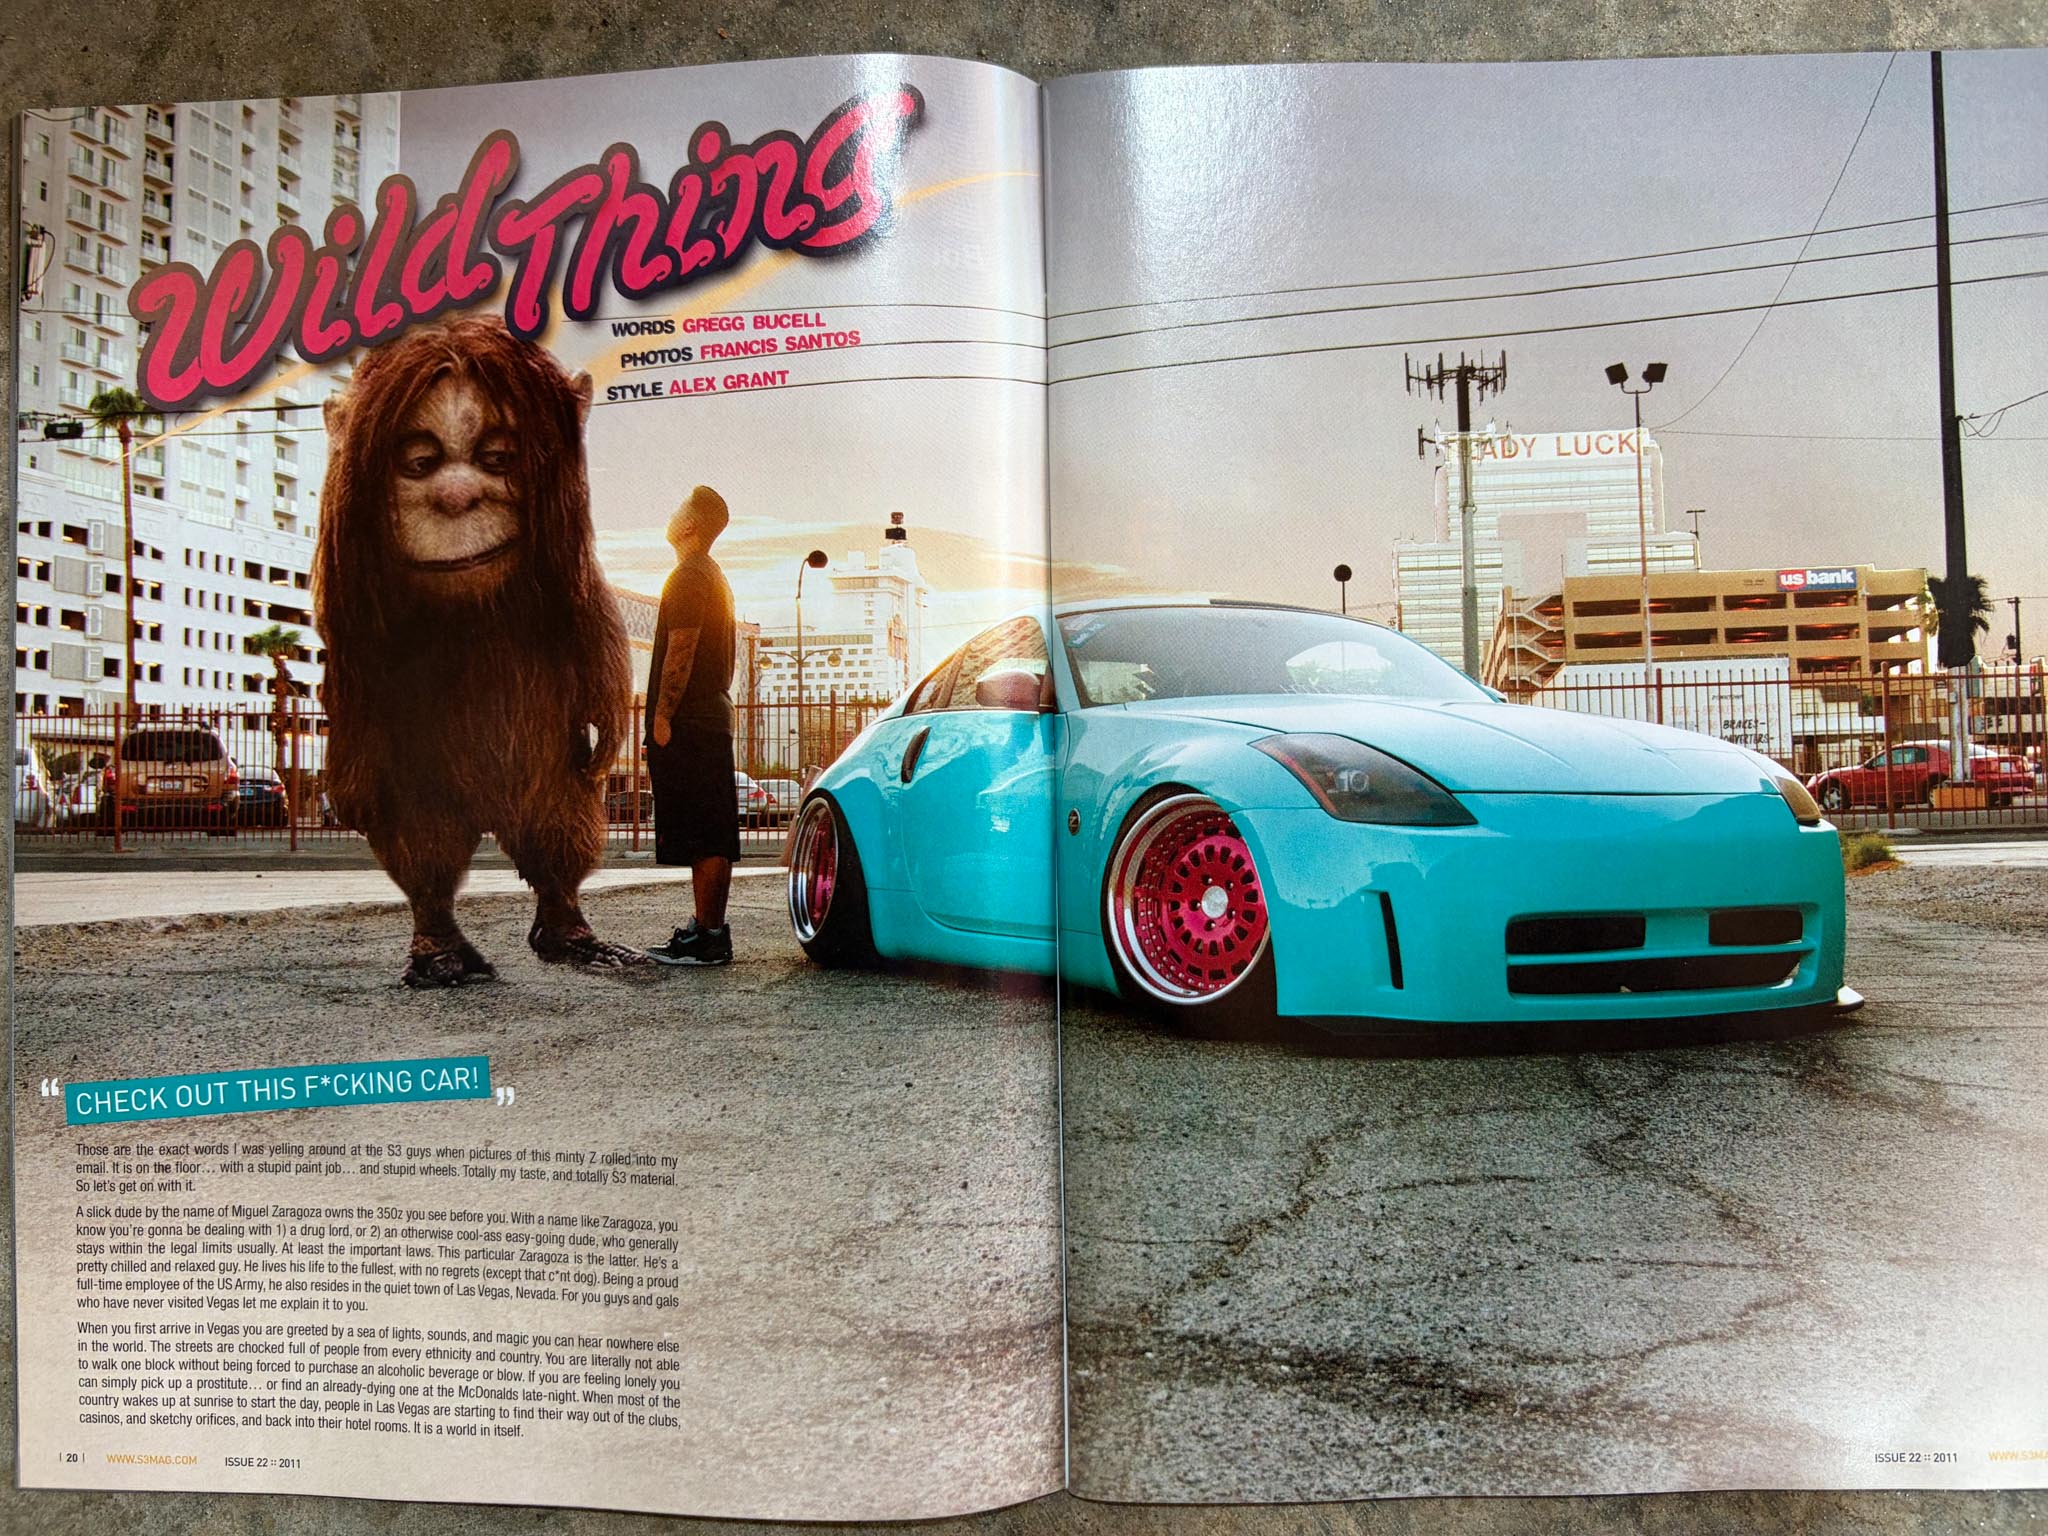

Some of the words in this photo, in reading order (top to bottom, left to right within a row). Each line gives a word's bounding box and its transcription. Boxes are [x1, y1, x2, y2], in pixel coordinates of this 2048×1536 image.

[127, 129, 502, 412] Wild
[488, 83, 925, 341] Thing
[612, 320, 675, 337] WORDS
[683, 316, 744, 333] GREGG
[753, 312, 826, 331] BUCELL
[621, 347, 693, 368] PHOTOS
[700, 338, 778, 360] FRANCIS
[785, 331, 861, 352] SANTOS
[607, 382, 663, 401] STYLE
[669, 376, 716, 395] ALEX
[723, 370, 789, 390] GRANT
[1467, 437, 1537, 461] ADY
[1556, 432, 1636, 457] LUCK
[76, 1087, 168, 1115] CHECK
[176, 1082, 229, 1107] OUT
[237, 1077, 296, 1103] THIS
[420, 1066, 479, 1092] CAR!
[76, 1178, 90, 1192] So
[118, 1178, 137, 1195] get
[139, 1181, 154, 1191] on
[156, 1178, 182, 1191] with
[184, 1178, 196, 1191] it.
[76, 1204, 84, 1217] A
[86, 1204, 112, 1217] slick
[114, 1204, 142, 1217] dude
[144, 1204, 159, 1221] by
[161, 1204, 180, 1217] the
[182, 1207, 214, 1217] name
[217, 1204, 228, 1217] of
[231, 1204, 269, 1221] Miguel
[271, 1204, 322, 1221] Zaragoza
[324, 1207, 354, 1218] owns
[356, 1205, 374, 1219] the
[376, 1205, 403, 1219] 350z
[405, 1209, 425, 1223] you
[427, 1210, 447, 1221] see
[449, 1208, 484, 1222] before
[486, 1212, 508, 1227] you.
[510, 1210, 535, 1224] With
[537, 1214, 544, 1225] a
[546, 1215, 578, 1227] name
[580, 1214, 600, 1228] like
[602, 1215, 656, 1234] Zaragoza,
[658, 1220, 678, 1235] you
[76, 1294, 100, 1307] who
[102, 1294, 130, 1308] have
[132, 1297, 164, 1308] never
[167, 1295, 204, 1308] visited
[206, 1295, 240, 1312] Vegas
[242, 1296, 256, 1309] let
[259, 1299, 277, 1309] me
[280, 1296, 319, 1313] explain
[322, 1296, 330, 1309] it
[332, 1297, 343, 1310] to
[345, 1299, 369, 1313] you.
[78, 1320, 108, 1333] When
[110, 1323, 131, 1337] you
[134, 1321, 156, 1334] first
[158, 1321, 191, 1334] arrive
[194, 1321, 204, 1334] in
[206, 1321, 240, 1338] Vegas
[242, 1325, 262, 1338] you
[265, 1325, 284, 1335] are
[286, 1322, 328, 1340] greeted
[330, 1323, 344, 1340] by
[346, 1326, 354, 1337] a
[356, 1327, 376, 1338] sea
[378, 1325, 389, 1338] of
[392, 1325, 424, 1343] lights,
[426, 1326, 470, 1343] sounds,
[472, 1328, 493, 1343] and
[495, 1330, 529, 1348] magic
[532, 1334, 551, 1349] you
[554, 1335, 574, 1347] can
[577, 1334, 603, 1348] hear
[606, 1335, 654, 1351] nowhere
[656, 1338, 679, 1352] else
[78, 1357, 89, 1369] to
[91, 1356, 118, 1369] walk
[120, 1359, 141, 1370] one
[144, 1357, 175, 1370] block
[178, 1357, 220, 1371] without
[222, 1358, 253, 1375] being
[256, 1358, 291, 1372] forced
[294, 1360, 305, 1372] to
[308, 1359, 358, 1378] purchase
[360, 1364, 374, 1375] an
[377, 1362, 425, 1377] alcoholic
[428, 1364, 479, 1383] beverage
[482, 1369, 494, 1380] or
[496, 1367, 525, 1382] blow.
[527, 1369, 535, 1382] If
[538, 1372, 559, 1387] you
[562, 1373, 580, 1384] are
[583, 1371, 621, 1389] feeling
[624, 1373, 657, 1391] lonely
[659, 1378, 680, 1392] you
[78, 1377, 98, 1387] can
[100, 1374, 137, 1391] simply
[140, 1375, 164, 1392] pick
[167, 1378, 182, 1392] up
[185, 1378, 193, 1389] a
[265, 1380, 278, 1390] or
[280, 1377, 302, 1391] find
[304, 1380, 319, 1391] an
[322, 1378, 396, 1398] already-dying
[398, 1384, 419, 1395] one
[422, 1383, 434, 1396] at
[436, 1383, 454, 1397] the
[458, 1384, 518, 1400] McDonalds
[521, 1387, 579, 1406] late-night.
[582, 1390, 614, 1405] When
[616, 1392, 645, 1406] most
[648, 1393, 659, 1407] of
[662, 1394, 680, 1408] the
[79, 1410, 123, 1426] casinos,
[125, 1411, 146, 1424] and
[149, 1411, 192, 1428] sketchy
[195, 1412, 238, 1427] orifices,
[241, 1412, 262, 1426] and
[264, 1413, 292, 1426] back
[294, 1413, 315, 1428] into
[317, 1415, 342, 1429] their
[344, 1416, 371, 1431] hotel
[374, 1421, 410, 1433] rooms.
[413, 1420, 421, 1433] It
[423, 1420, 433, 1434] is
[435, 1424, 443, 1434] a
[446, 1421, 477, 1435] world
[480, 1422, 490, 1436] in
[493, 1423, 523, 1437] itself.
[66, 1453, 78, 1463] 20
[106, 1454, 198, 1465] WWW.S3MAG.COM
[225, 1457, 254, 1468] ISSUE
[256, 1457, 269, 1468] 22
[279, 1458, 301, 1469] 2011
[1875, 1453, 1906, 1463] ISSUE
[1908, 1453, 1921, 1462] 22
[1933, 1453, 1958, 1463] 2011
